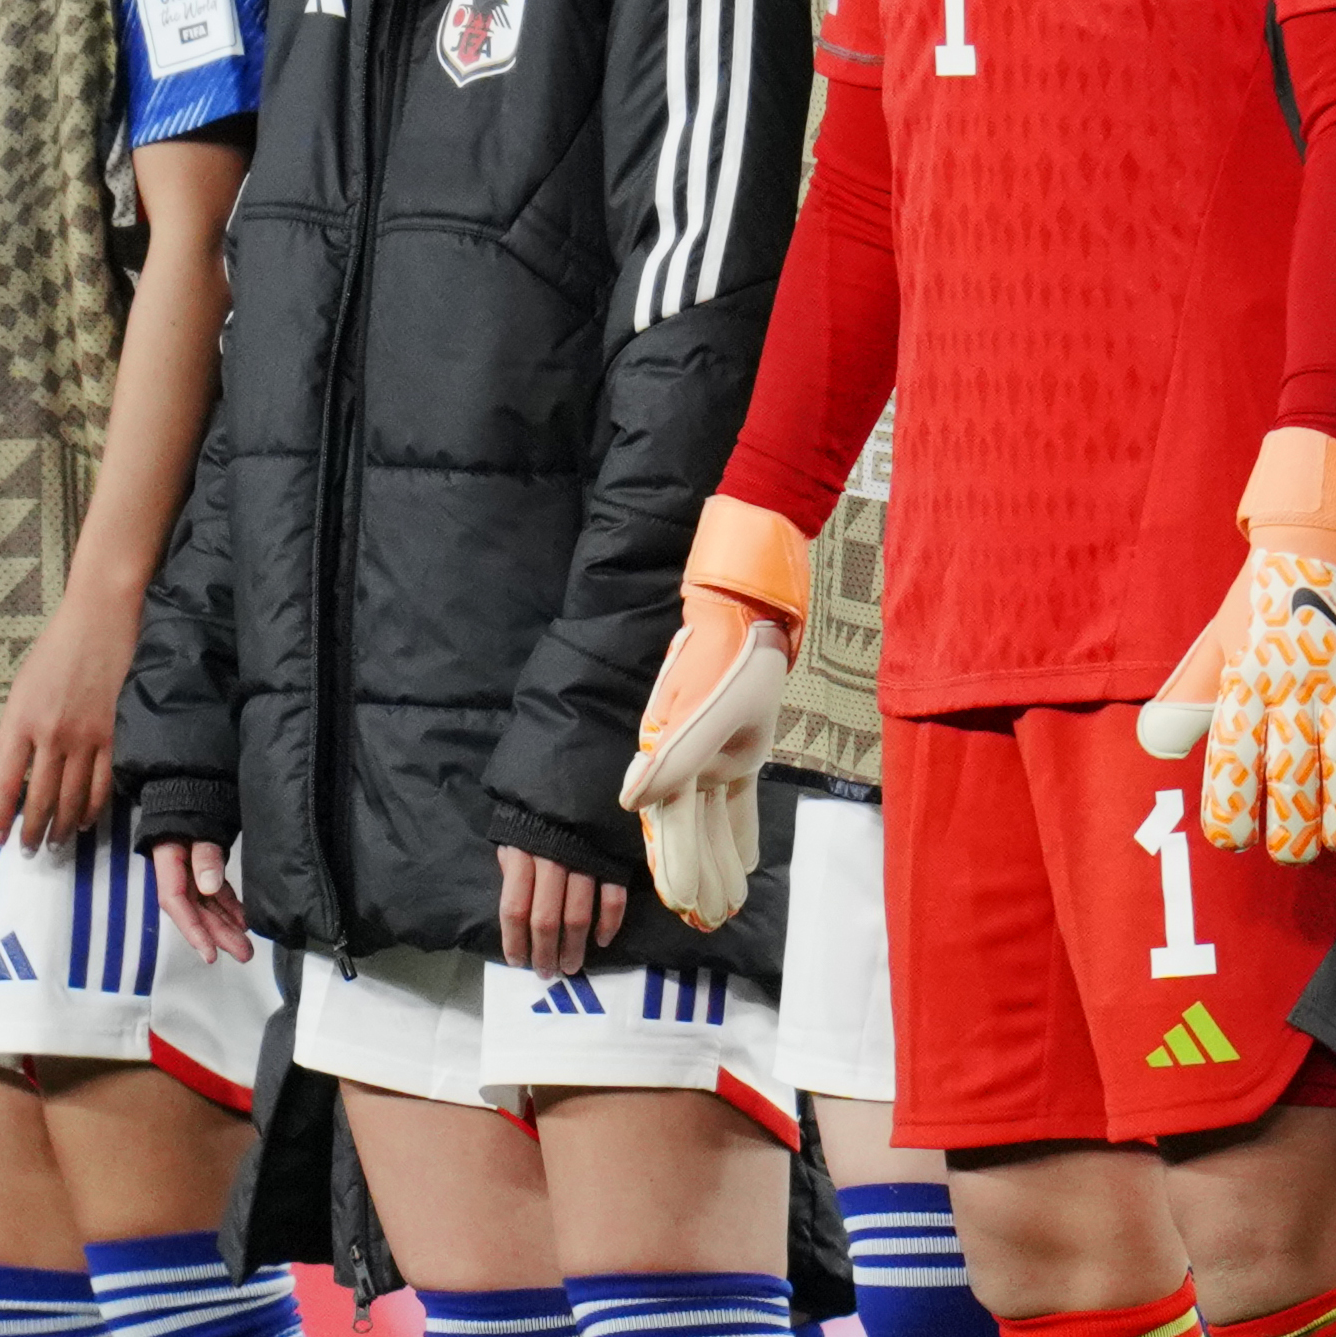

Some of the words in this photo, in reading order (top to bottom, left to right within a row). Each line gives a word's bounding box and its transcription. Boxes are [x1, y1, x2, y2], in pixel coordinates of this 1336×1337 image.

[159, 5, 181, 28] the
[181, 23, 208, 43] FIFA
[450, 32, 493, 59] JFA
[1133, 789, 1217, 979] 1
